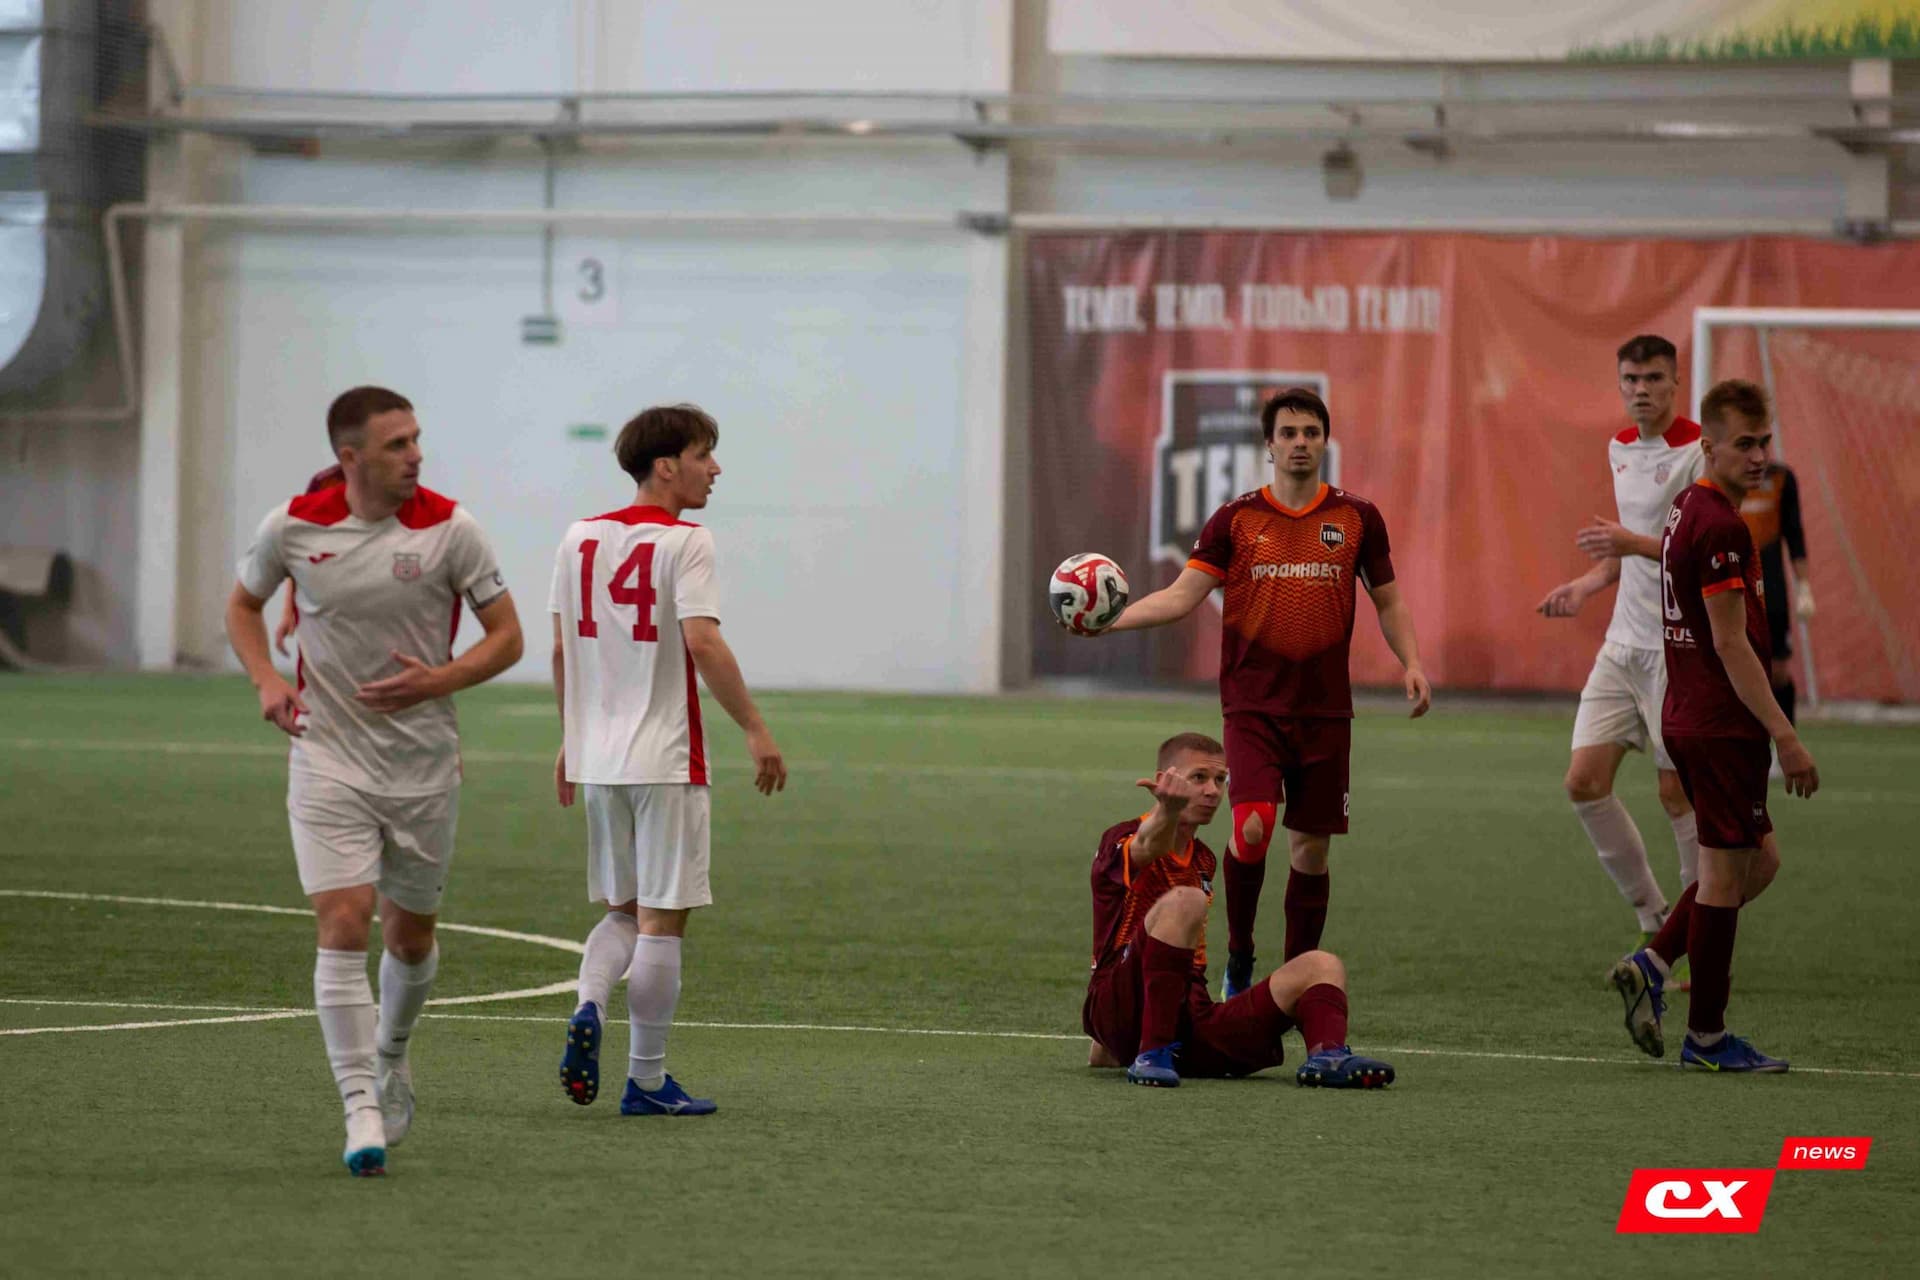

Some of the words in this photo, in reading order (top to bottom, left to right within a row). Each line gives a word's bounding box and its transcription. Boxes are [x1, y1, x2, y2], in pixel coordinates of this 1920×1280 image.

[578, 257, 606, 302] 3
[1242, 284, 1350, 332] ТОЛЬКО
[1322, 531, 1343, 543] ТЕМП
[578, 538, 658, 642] 14
[1250, 562, 1342, 582] ПРОДИНВЕСТ
